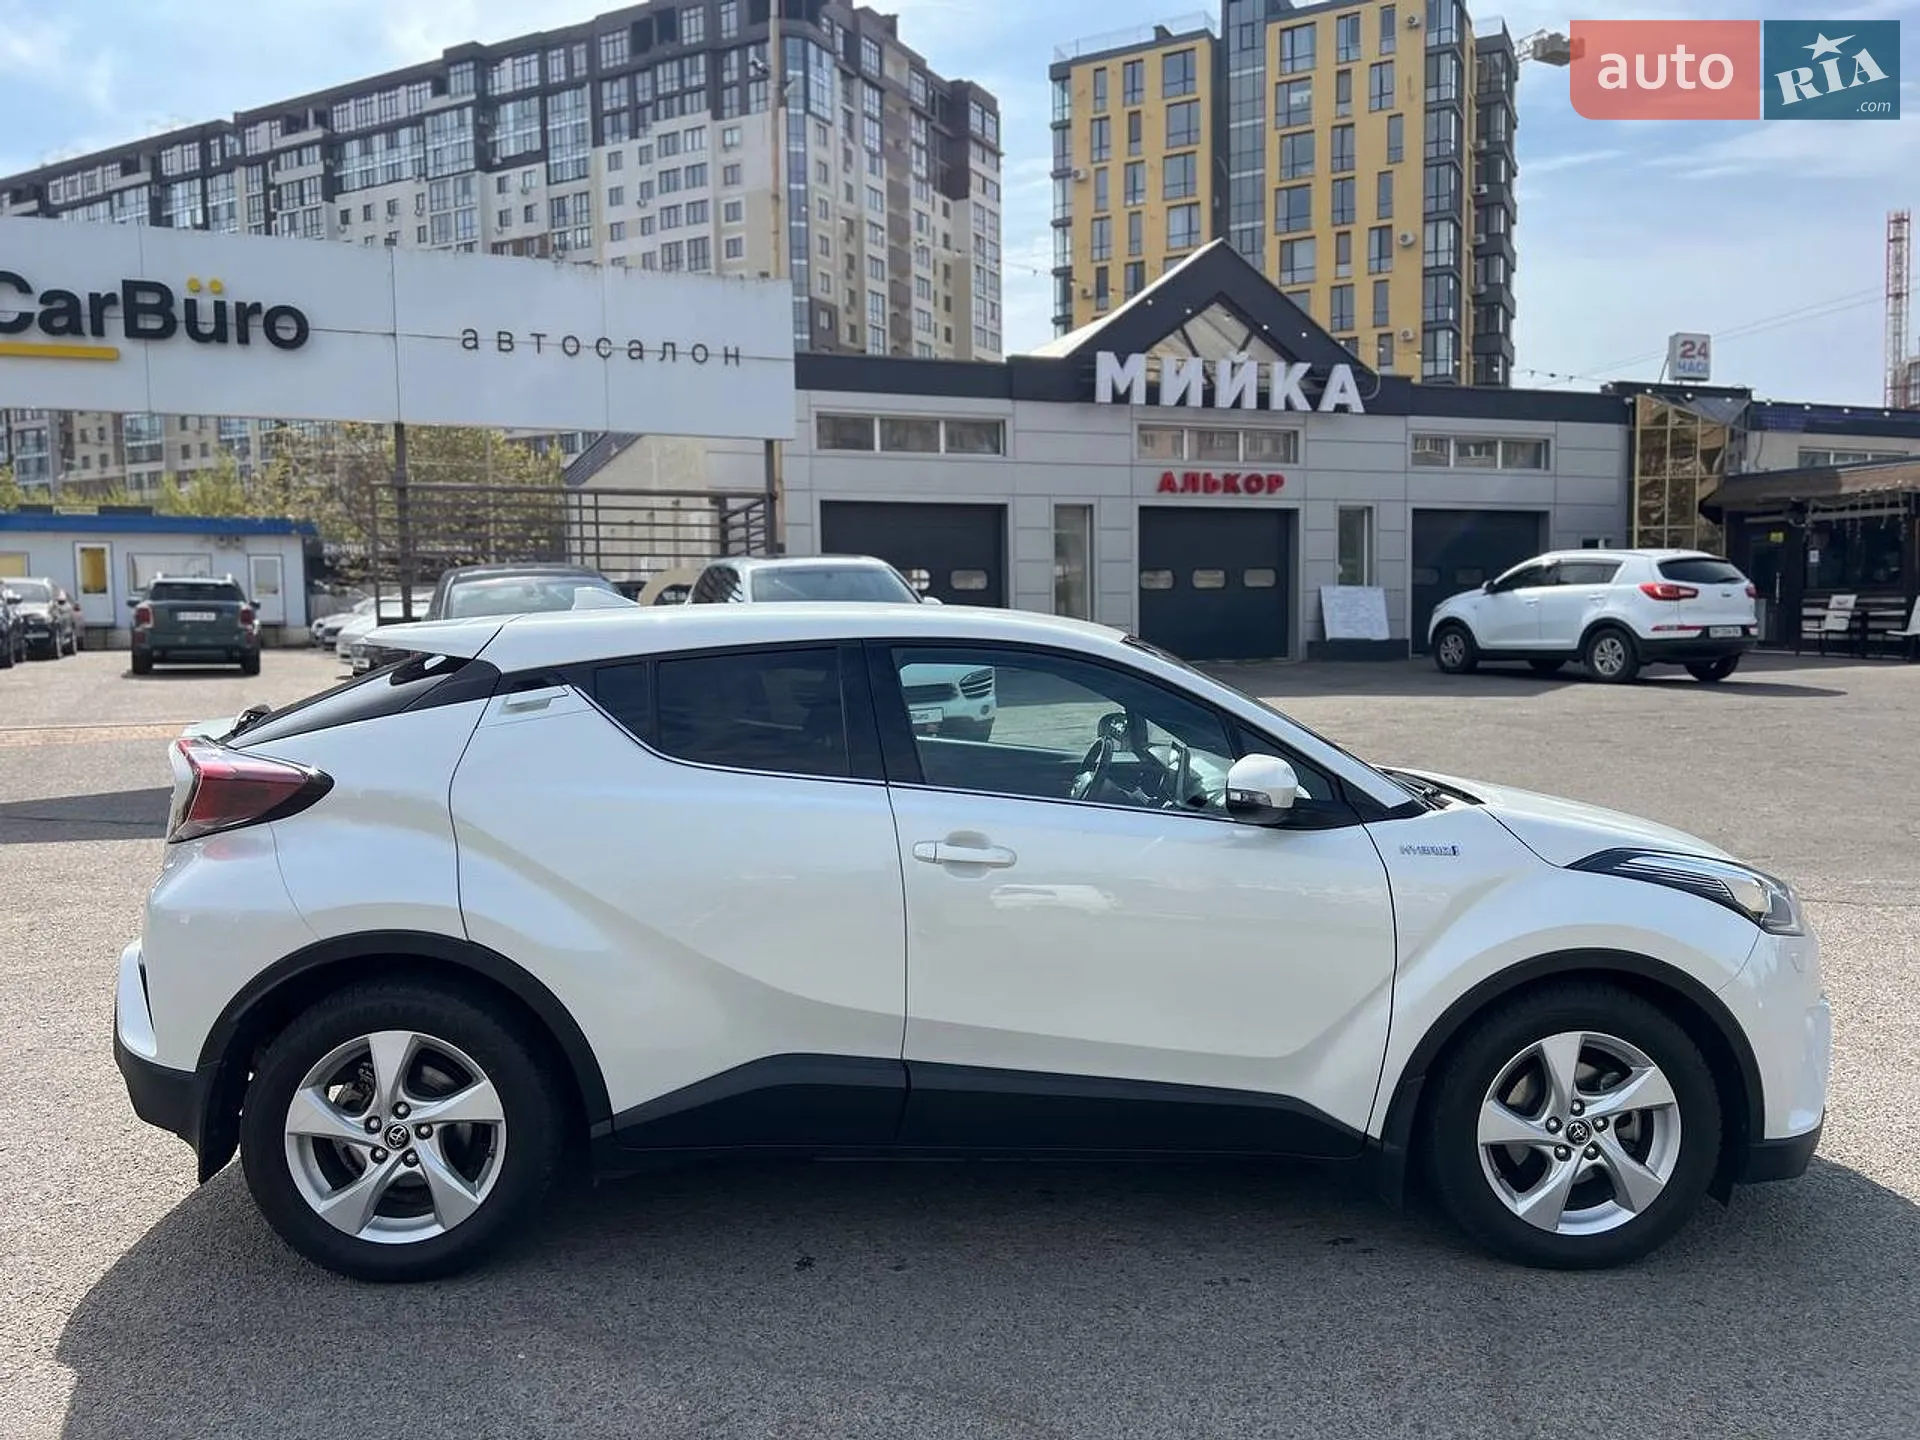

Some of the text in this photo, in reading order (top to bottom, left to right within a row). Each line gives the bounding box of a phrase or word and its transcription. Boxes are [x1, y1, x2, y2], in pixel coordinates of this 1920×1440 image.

[0, 270, 310, 350] CarBüro
[460, 328, 741, 366] автосалон
[1680, 340, 1709, 360] 24
[1095, 350, 1365, 413] МИЙКА
[1157, 471, 1286, 495] АЛЬКОР
